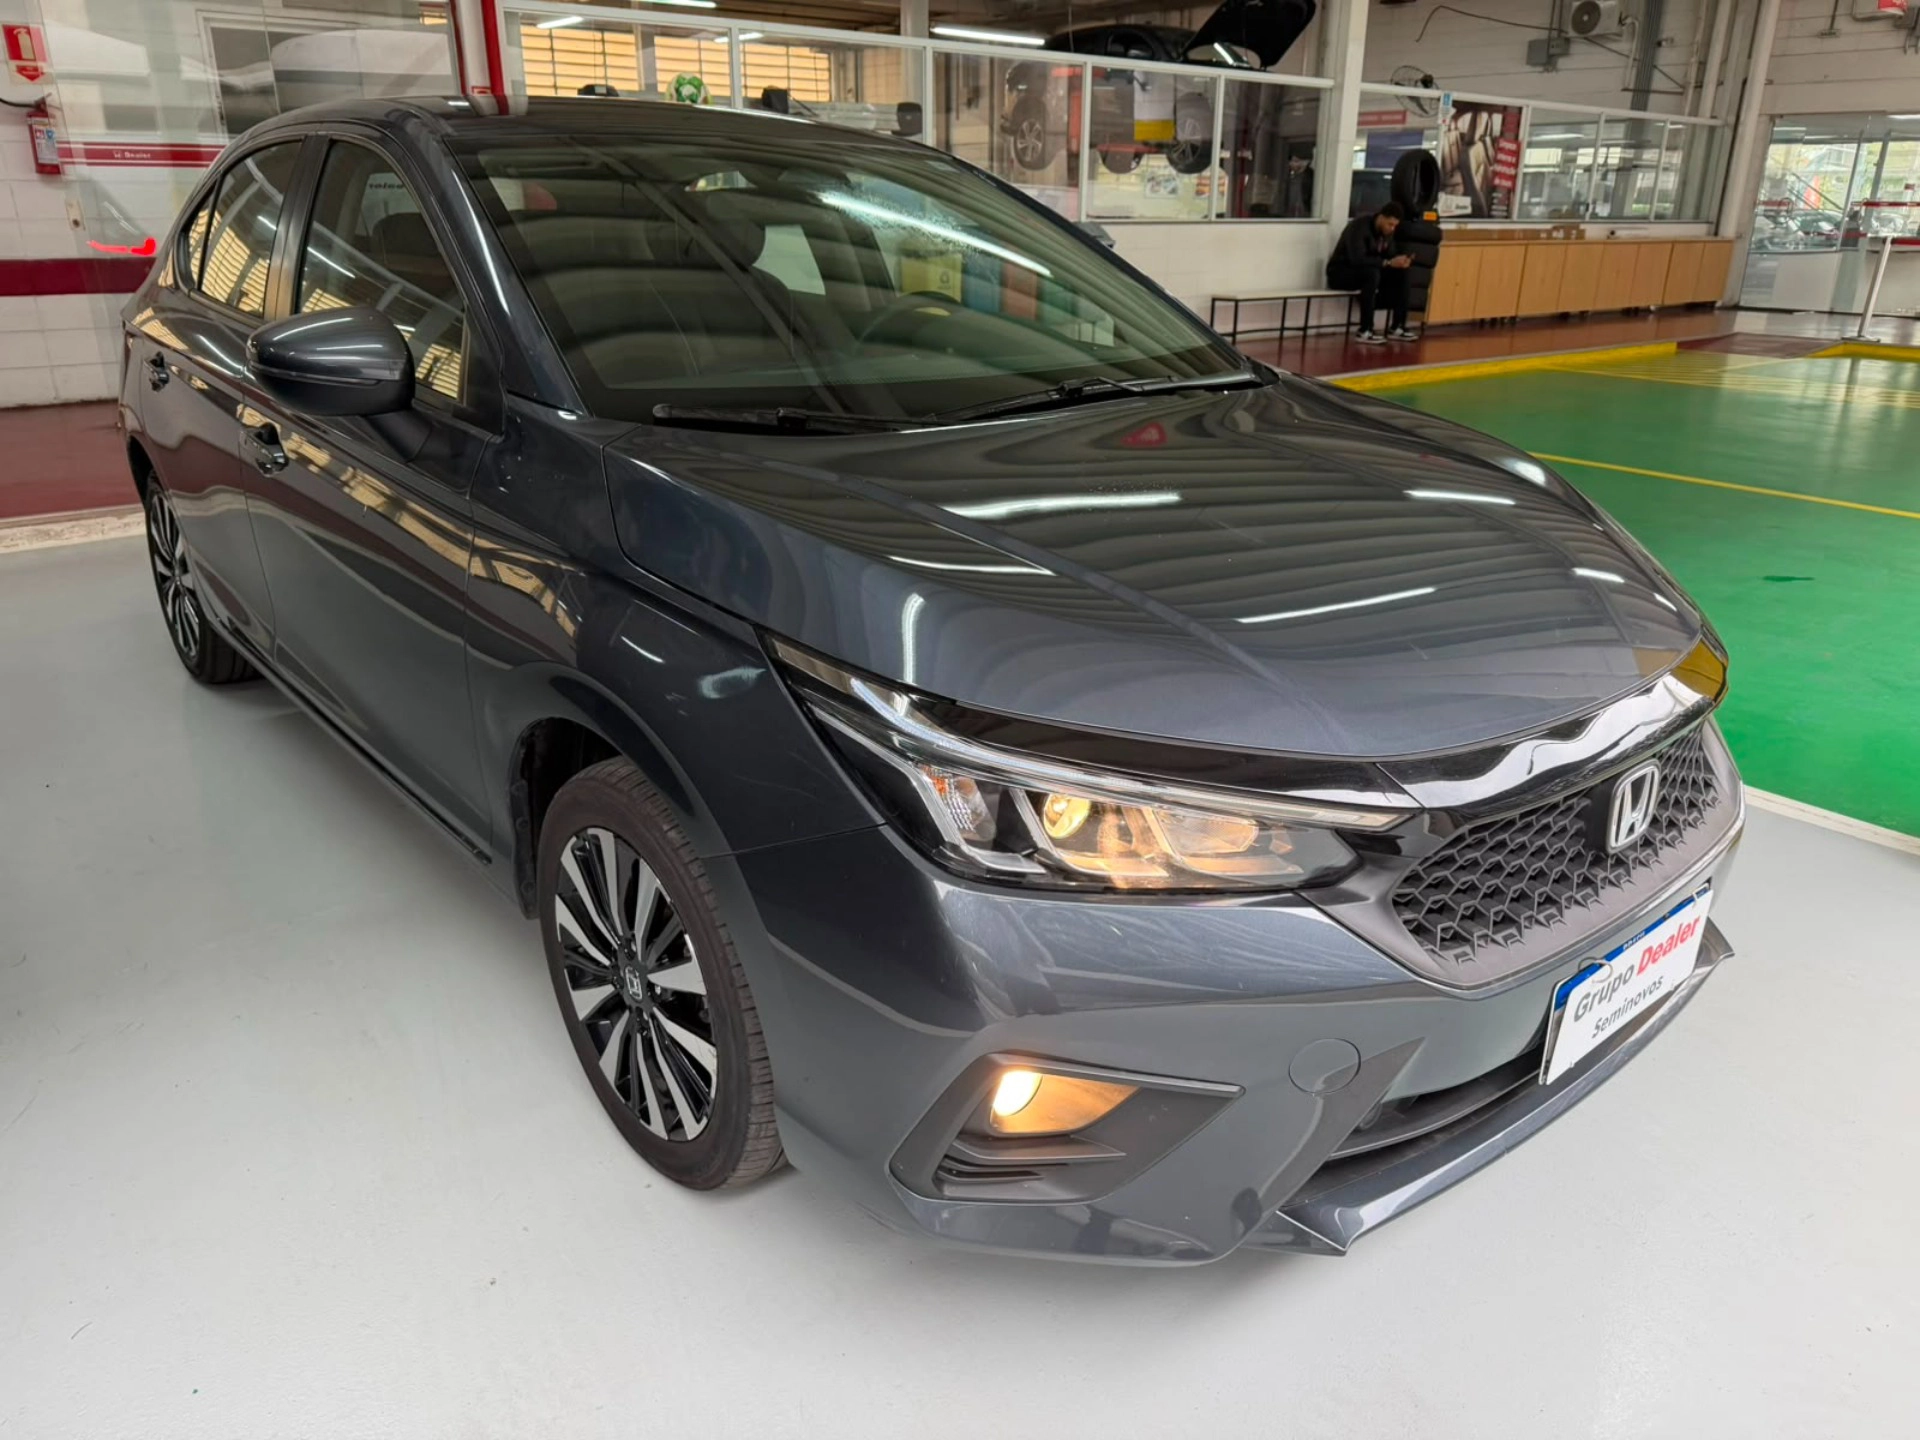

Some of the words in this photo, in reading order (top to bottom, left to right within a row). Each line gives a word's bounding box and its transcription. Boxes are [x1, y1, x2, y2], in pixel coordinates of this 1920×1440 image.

[1574, 964, 1635, 1022] Grupo
[1637, 917, 1700, 976] Dealer
[1592, 976, 1664, 1039] Seminovos
